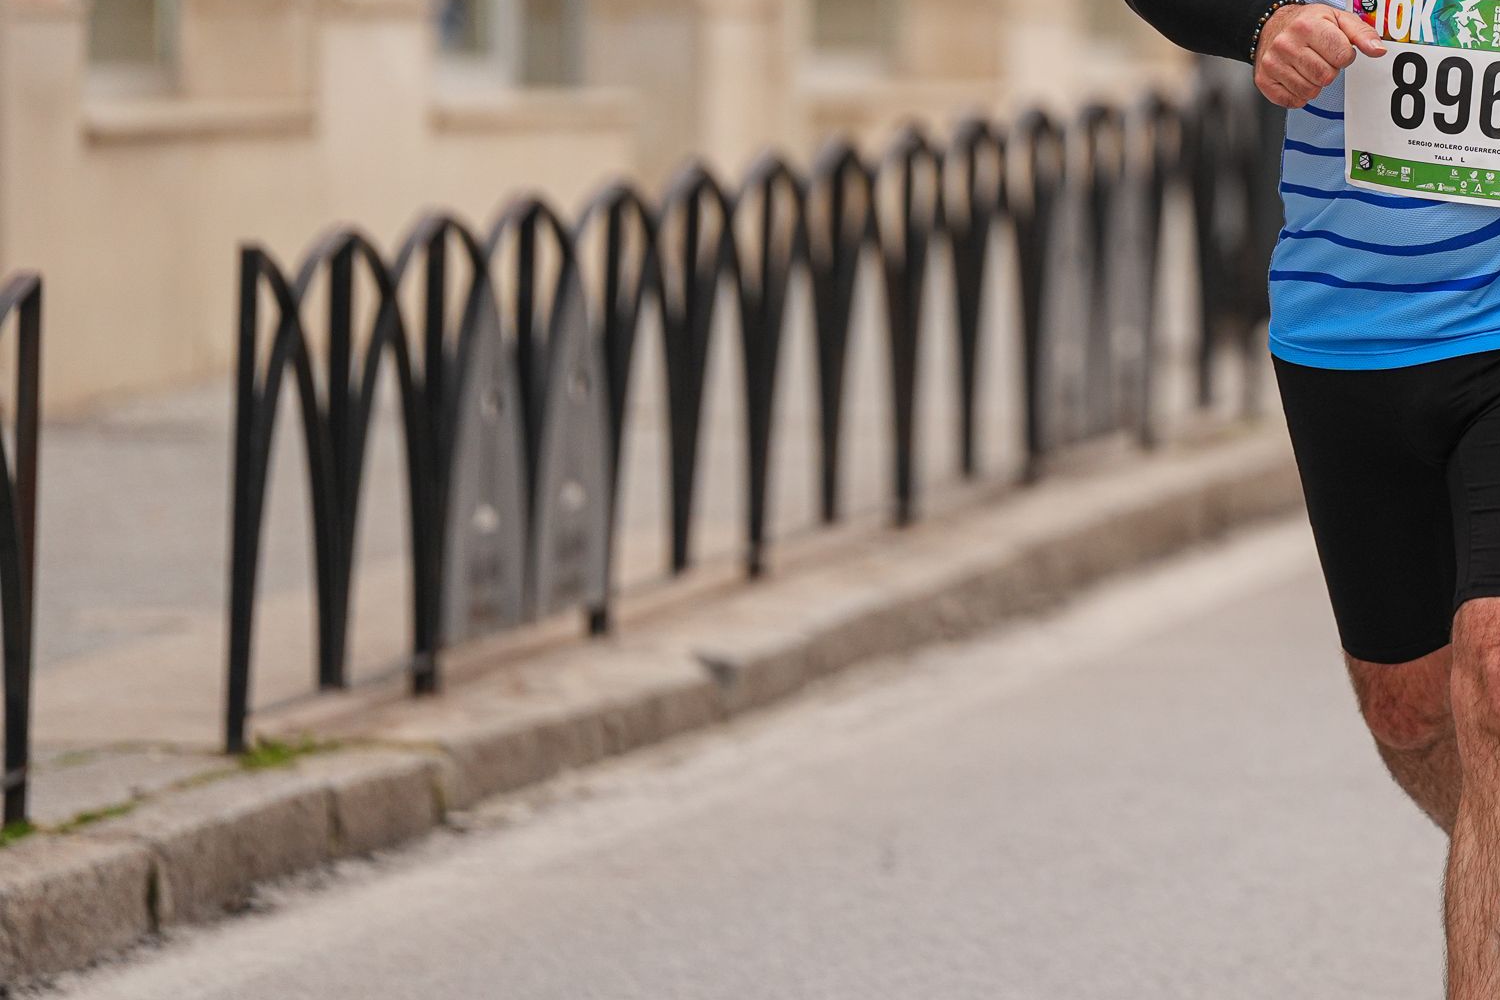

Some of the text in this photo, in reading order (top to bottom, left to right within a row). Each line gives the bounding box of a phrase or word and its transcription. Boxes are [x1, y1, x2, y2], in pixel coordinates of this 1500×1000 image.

[1407, 139, 1433, 148] SERGIO
[1434, 142, 1463, 151] MOLERO
[1434, 154, 1453, 162] TALLA
